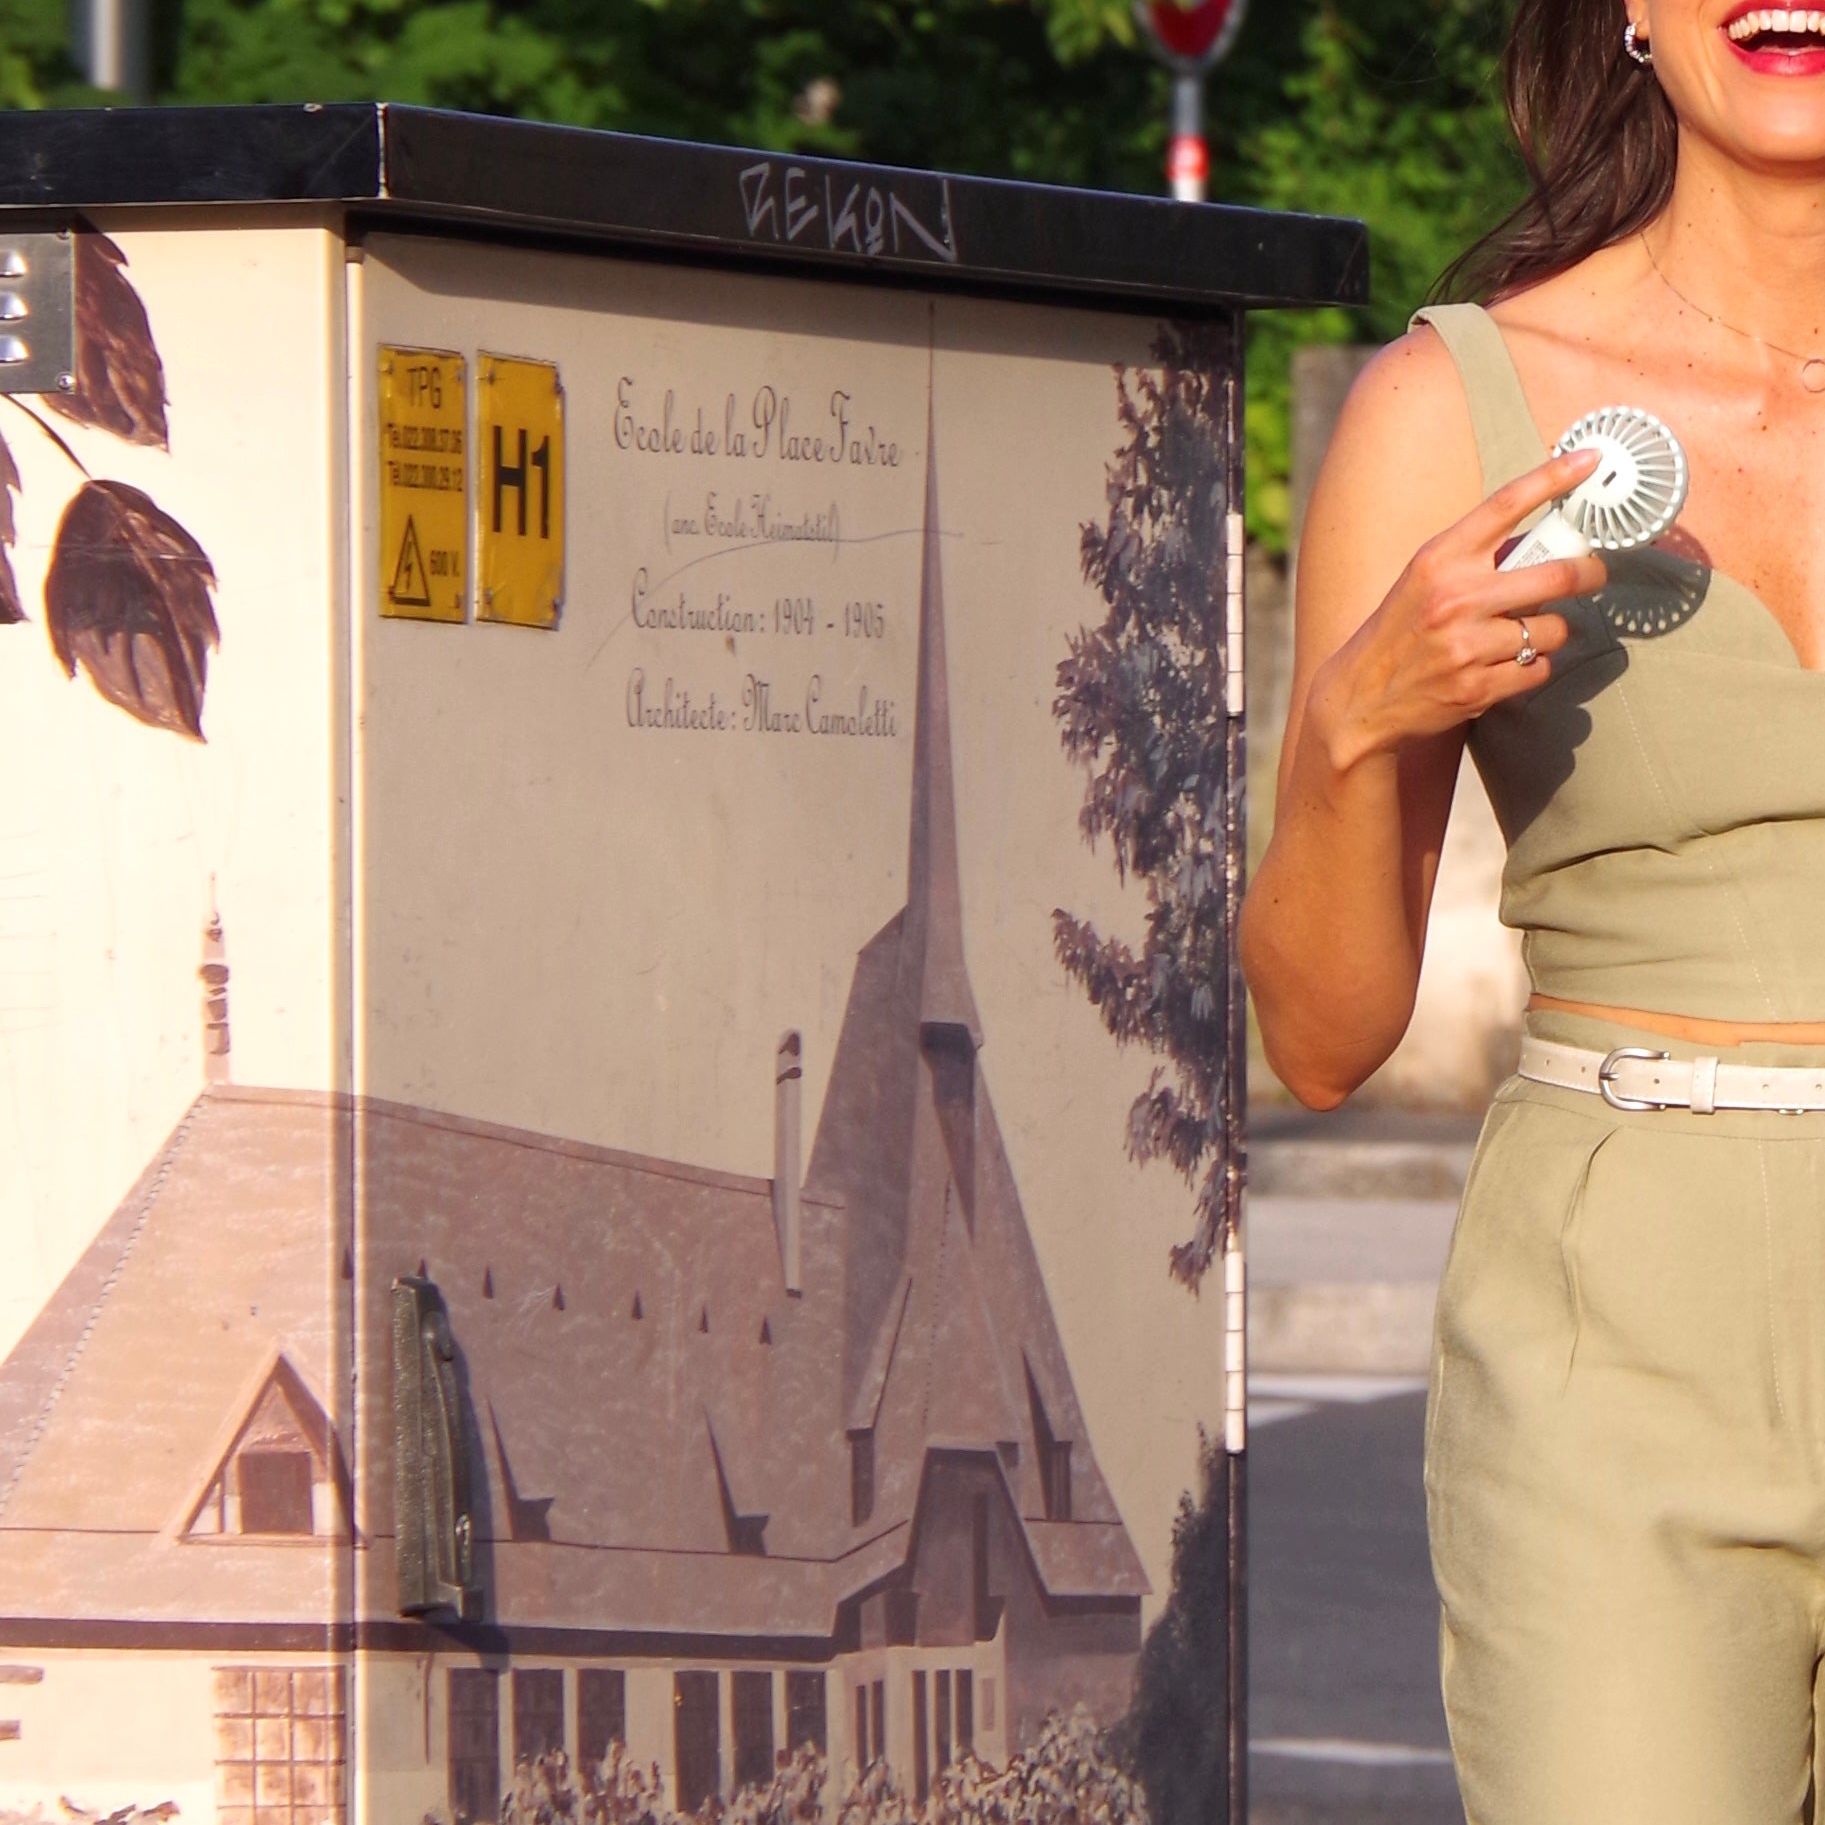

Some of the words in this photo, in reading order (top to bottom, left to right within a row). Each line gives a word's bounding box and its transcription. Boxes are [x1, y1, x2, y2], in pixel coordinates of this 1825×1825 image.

[406, 365, 441, 410] TPG
[613, 376, 683, 454] Ecole
[690, 406, 717, 456] de
[724, 392, 747, 458] la
[752, 385, 824, 462] Place
[829, 390, 900, 467] Favre
[492, 424, 550, 539] H1
[774, 597, 814, 636] 1904
[742, 673, 801, 733] Marc
